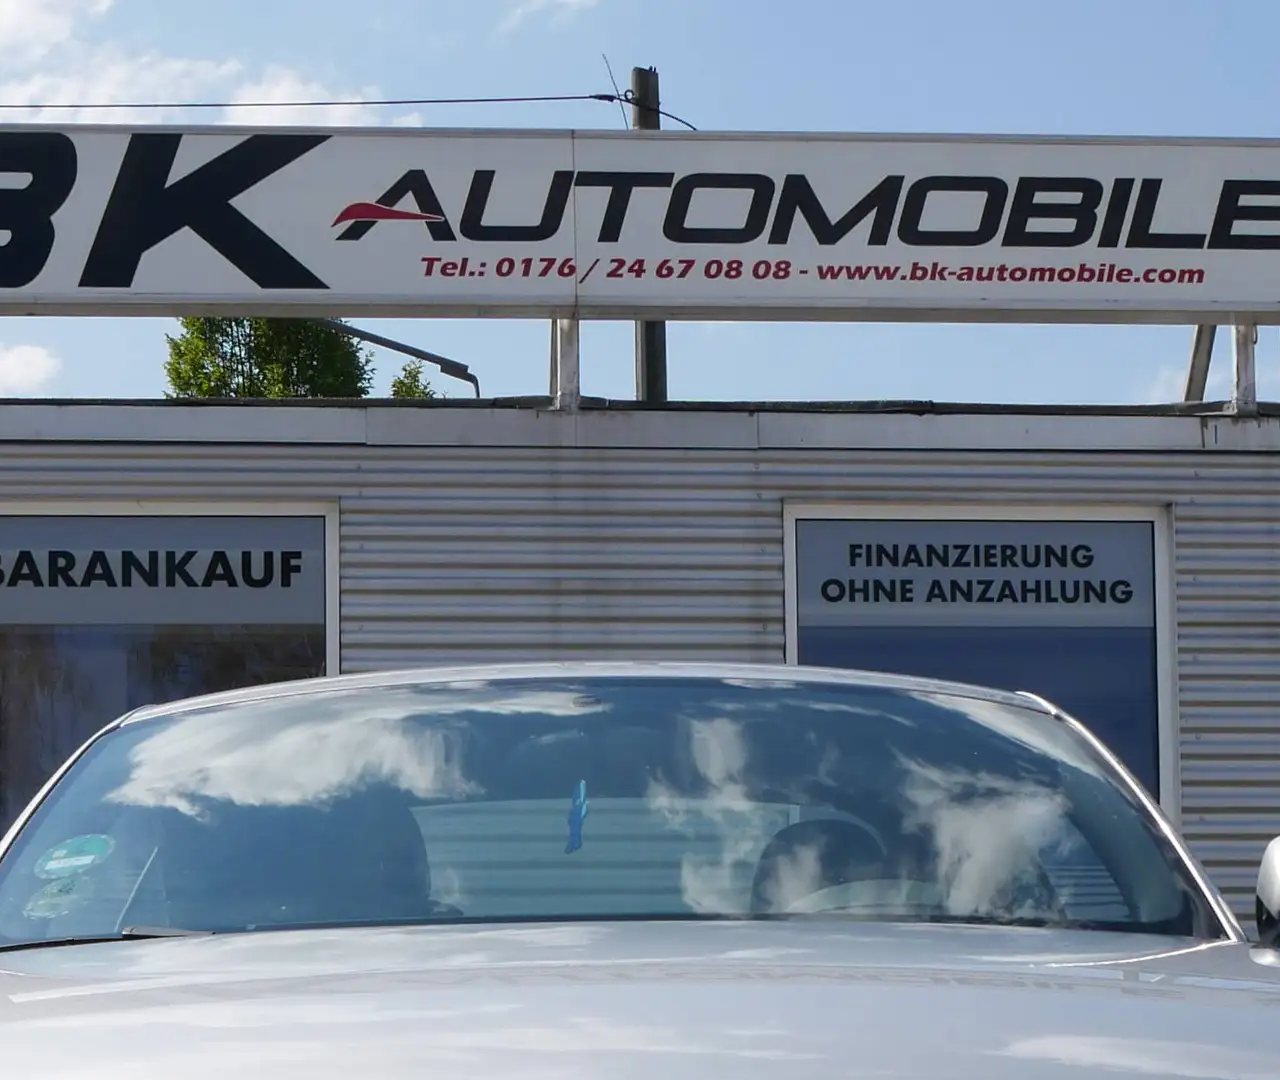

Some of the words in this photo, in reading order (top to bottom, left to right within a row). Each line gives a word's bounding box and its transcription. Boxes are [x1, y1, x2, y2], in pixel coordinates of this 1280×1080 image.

[421, 256, 486, 277] Tel.:
[496, 257, 577, 278] 0176
[606, 258, 646, 279] 24
[656, 259, 695, 279] 67
[704, 259, 743, 280] 08
[752, 260, 791, 280] 08
[817, 261, 1205, 284] www.bk-automobile.com
[849, 543, 1094, 568] FINANZIERUNG
[821, 579, 914, 603] OHNE
[926, 579, 1133, 604] ANZAHLUNG
